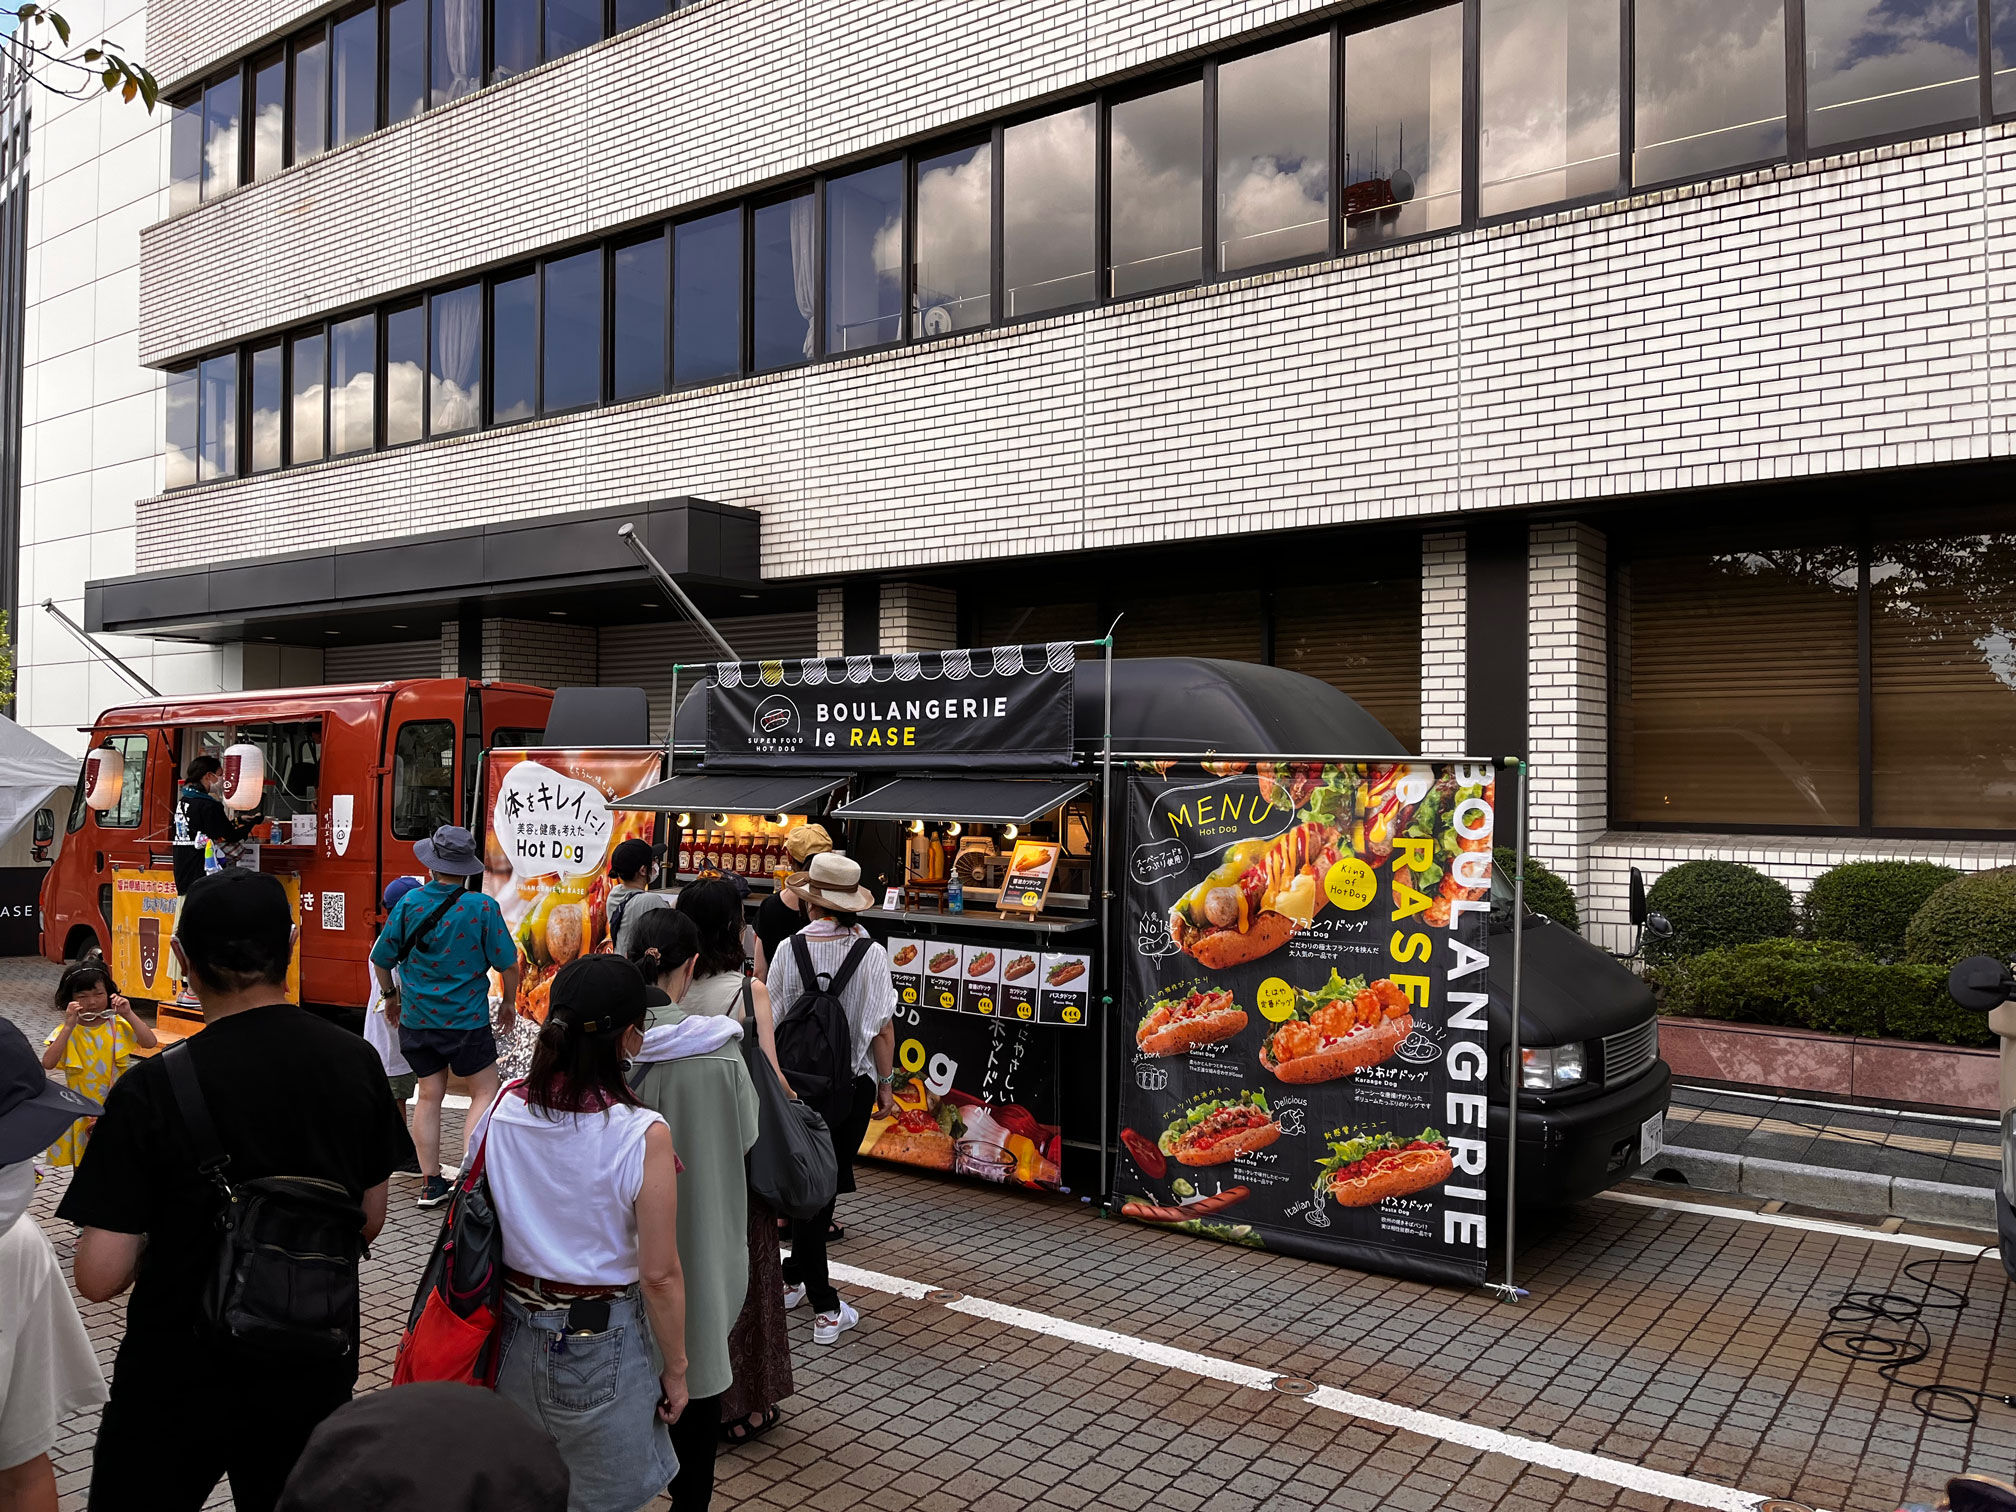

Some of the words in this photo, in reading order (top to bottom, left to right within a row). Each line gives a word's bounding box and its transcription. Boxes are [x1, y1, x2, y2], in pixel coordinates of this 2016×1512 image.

[816, 696, 1007, 722] BOULANGERIE
[849, 727, 916, 747] RASE
[1167, 793, 1274, 837] MENU
[1200, 828, 1216, 836] Hot
[1219, 825, 1238, 836] Dog
[516, 839, 545, 858] Hot
[552, 841, 584, 863] Dog
[1341, 864, 1365, 878] King
[1344, 878, 1357, 886] of
[0, 905, 33, 918] ASE
[1289, 917, 1368, 933] フランクドッグ
[1389, 838, 1434, 1008] RASE
[1289, 929, 1311, 937] Frank
[1313, 930, 1329, 939] Dog
[1442, 764, 1495, 1249] BOULANGERIE
[1408, 1019, 1433, 1032] Juicy
[1142, 1051, 1161, 1062] pork
[974, 1019, 1006, 1124] ホットドッグ
[1354, 1066, 1428, 1082] からあげドッグ
[1274, 1095, 1308, 1110] Delicious
[1234, 1148, 1278, 1163] ビーフドッグ
[1284, 1200, 1311, 1218] Italian
[1381, 1196, 1433, 1212] パスタドッグ
[1398, 1208, 1410, 1216] Dog
